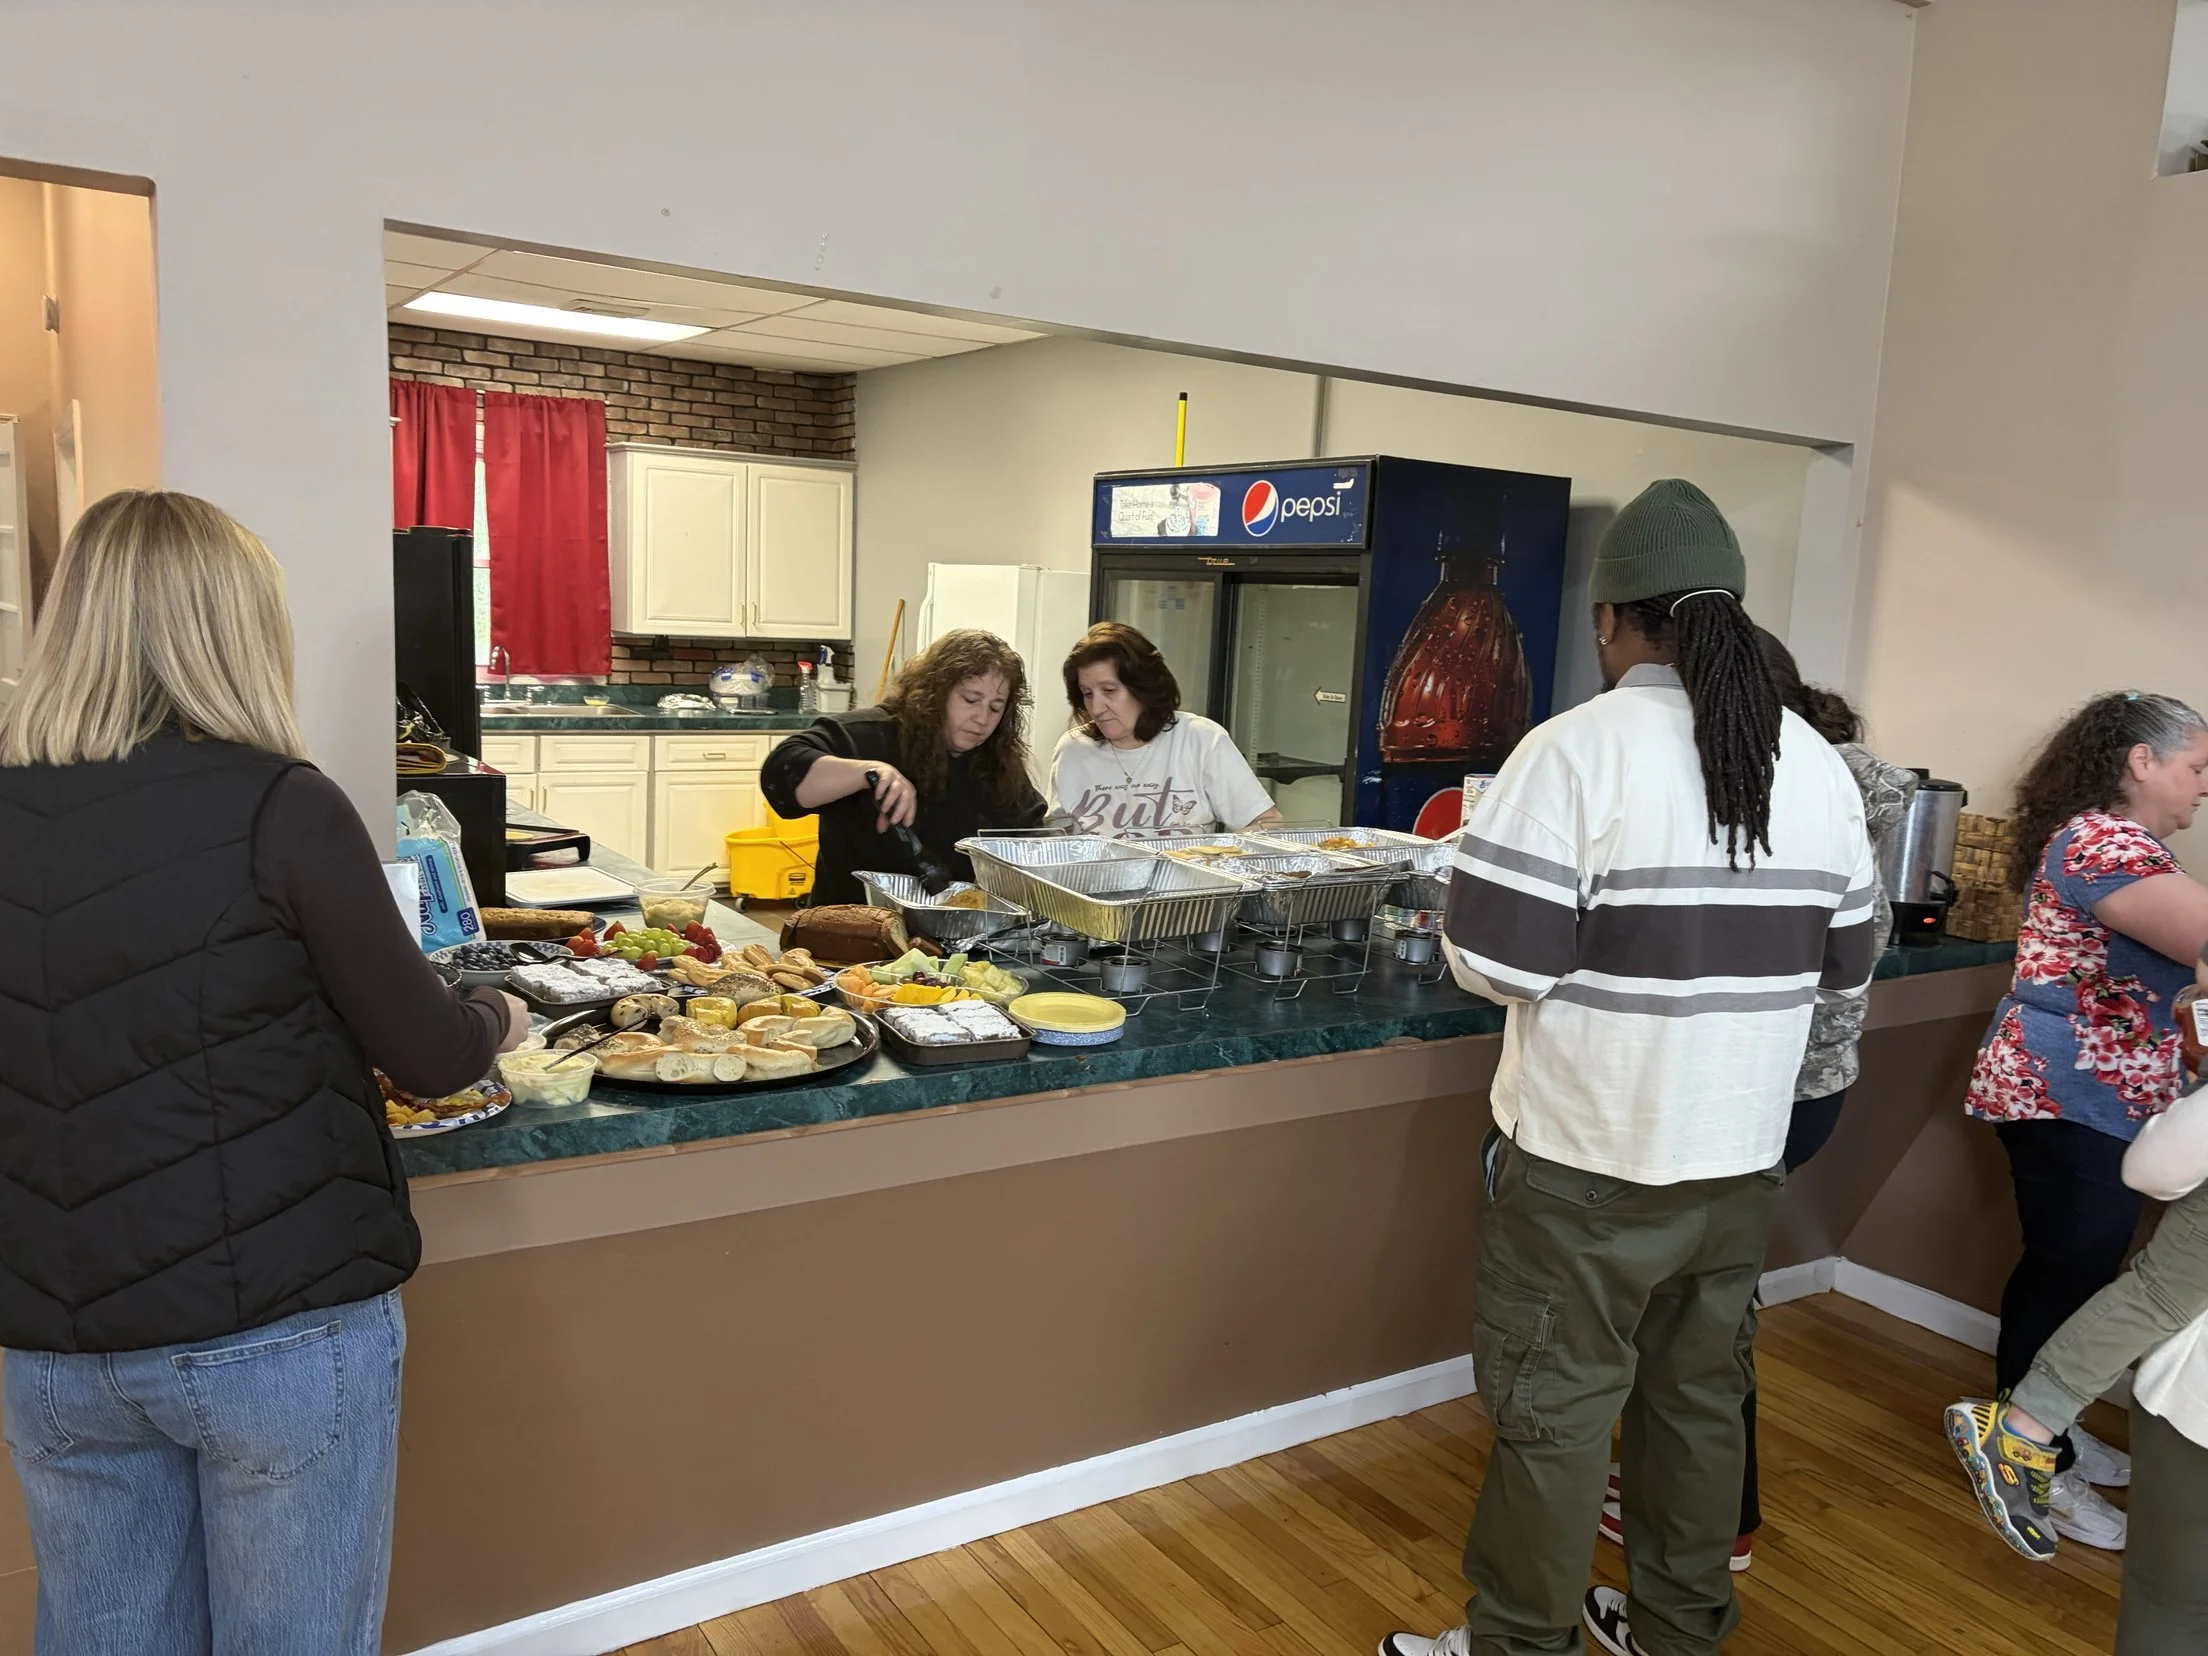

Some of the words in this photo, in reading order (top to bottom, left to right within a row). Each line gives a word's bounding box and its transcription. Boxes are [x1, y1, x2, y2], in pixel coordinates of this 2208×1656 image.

[1118, 511, 1135, 521] Quart
[1281, 490, 1341, 523] pepsi
[1095, 784, 1112, 792] There
[1071, 776, 1194, 833] But
[460, 911, 475, 933] 280
